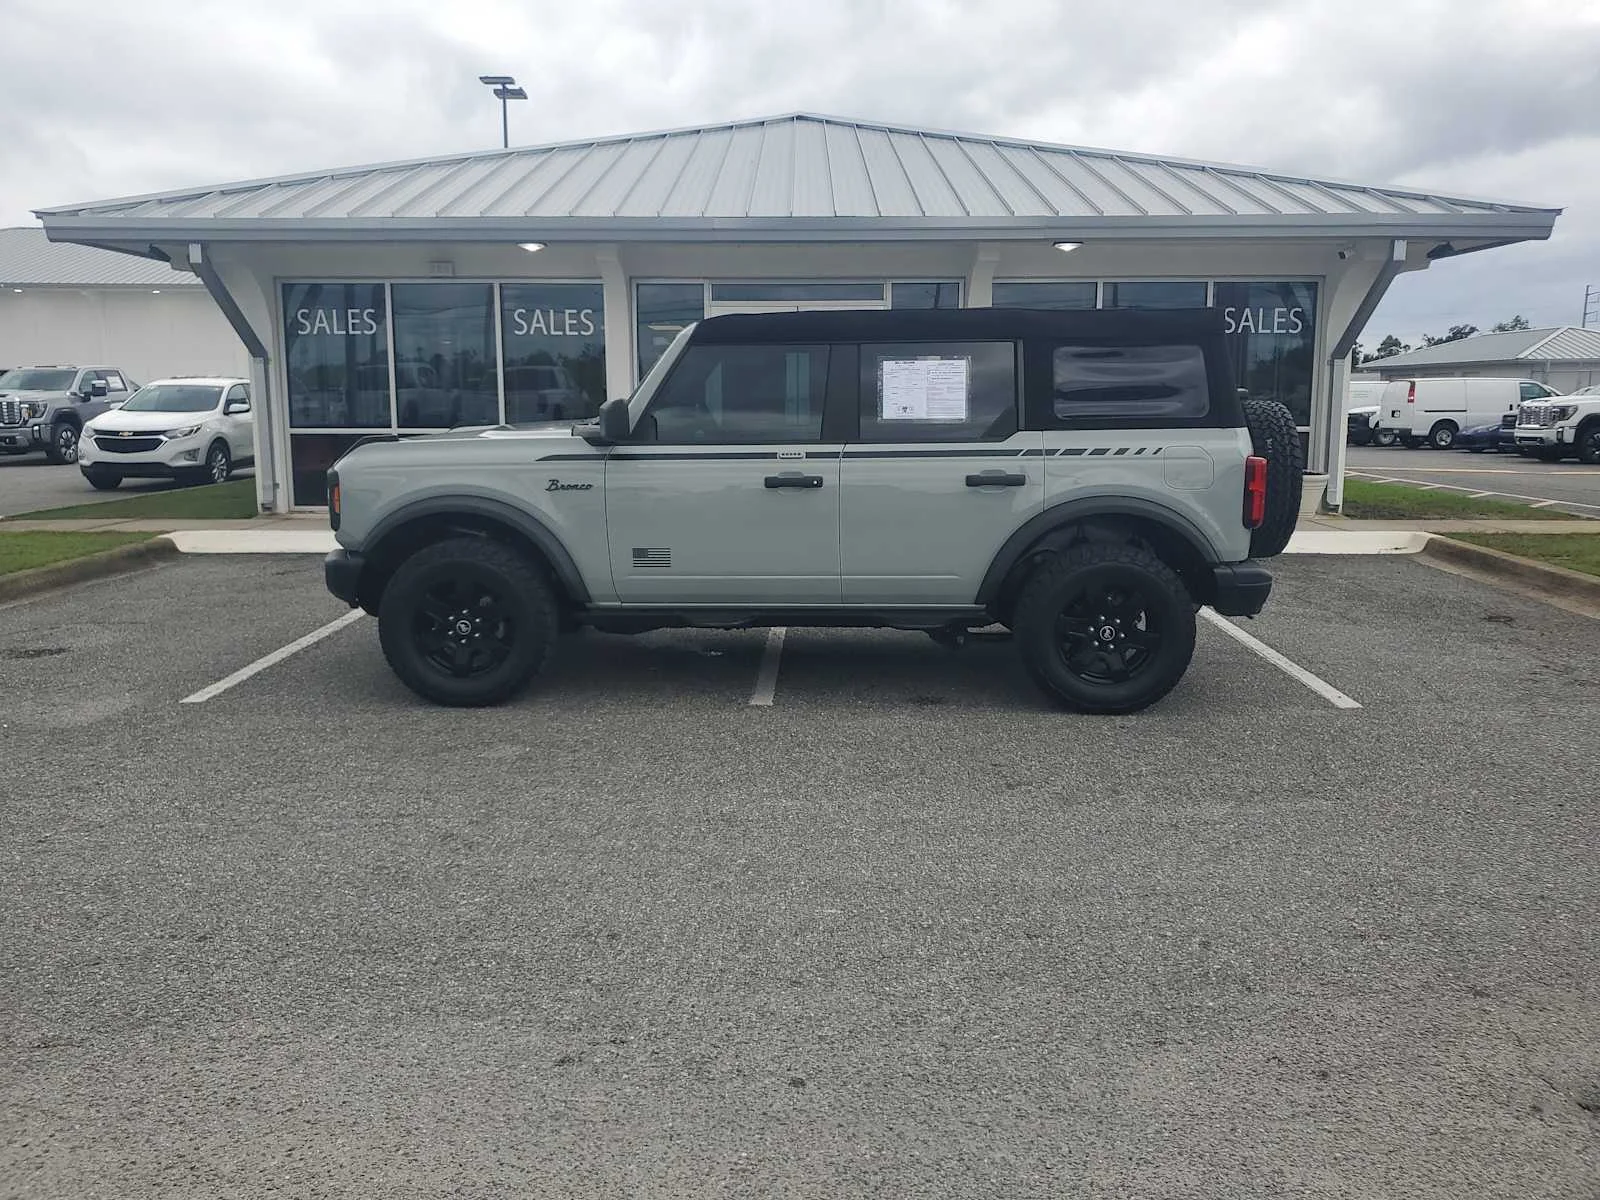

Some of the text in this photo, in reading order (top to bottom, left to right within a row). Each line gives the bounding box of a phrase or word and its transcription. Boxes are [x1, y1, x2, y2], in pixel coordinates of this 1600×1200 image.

[297, 308, 377, 335] SALES
[513, 308, 594, 335] SALES
[1224, 307, 1303, 334] SALES
[544, 479, 594, 491] Bronco
